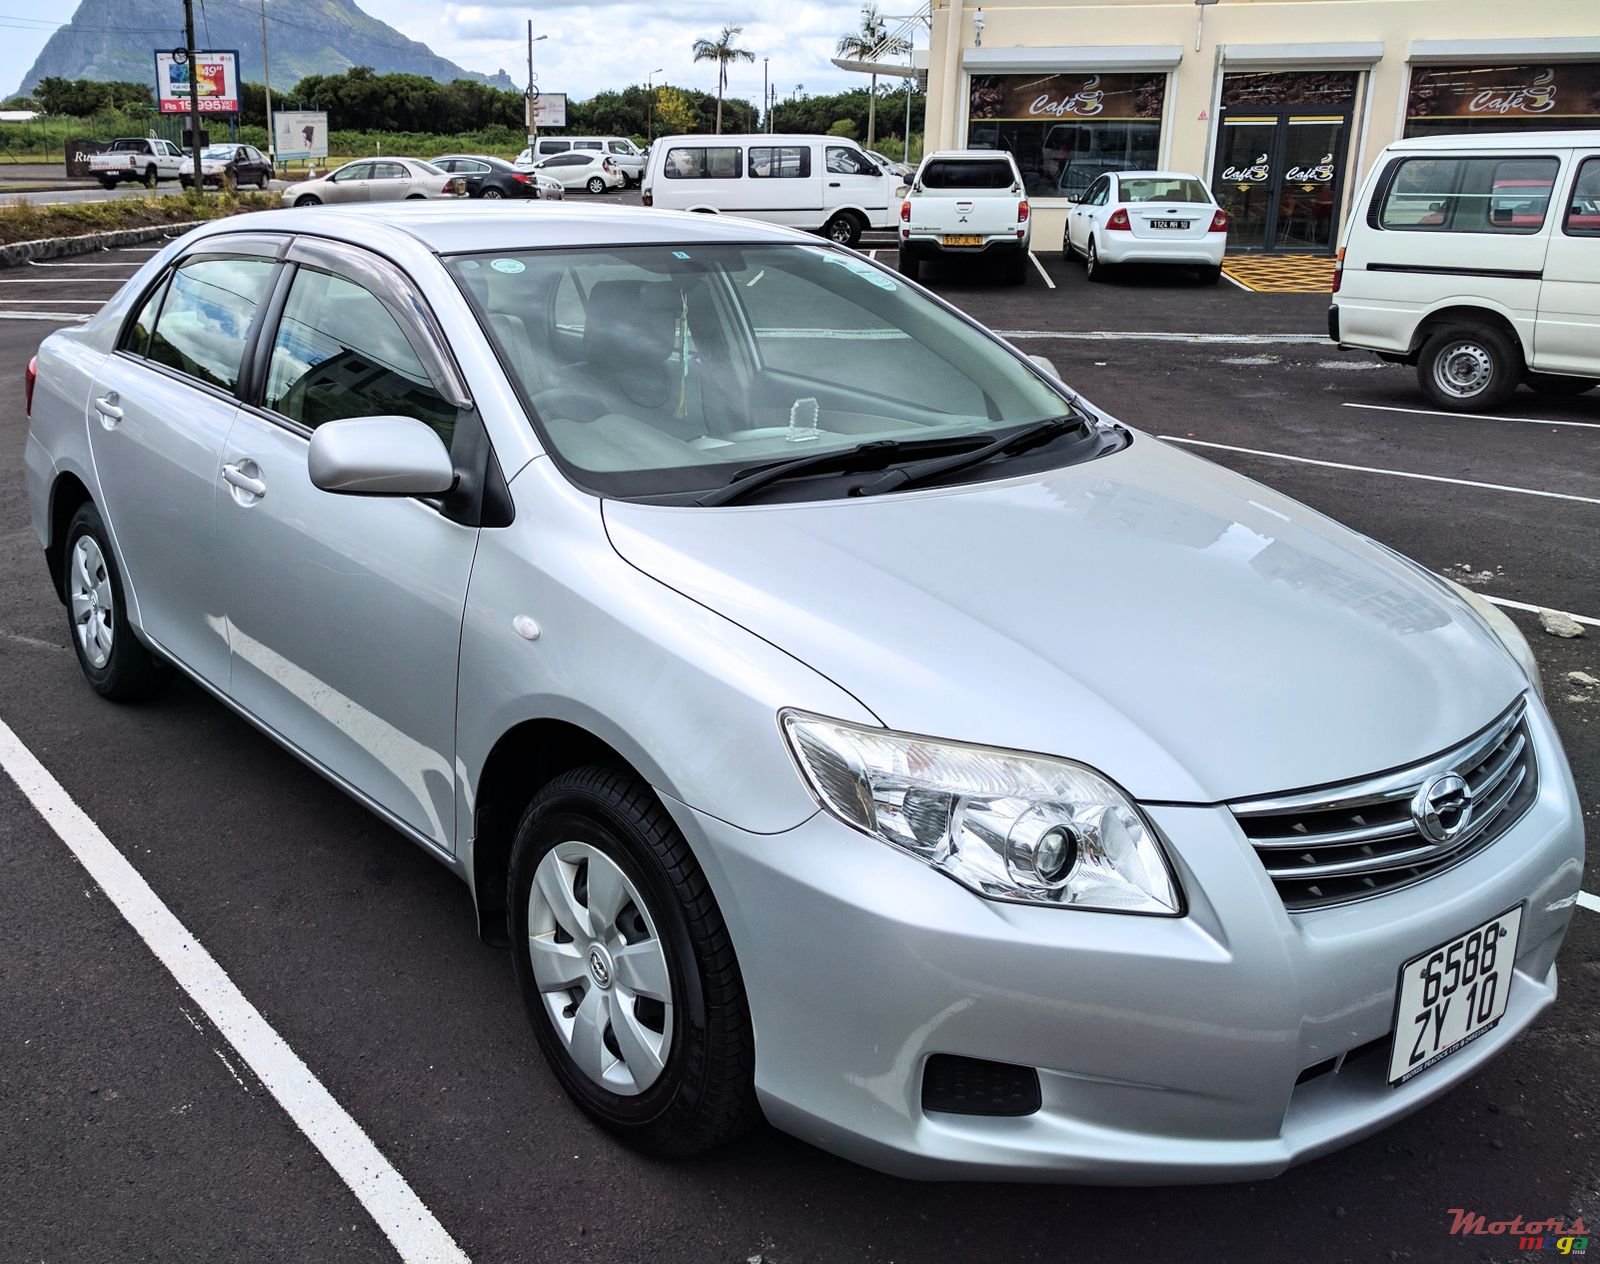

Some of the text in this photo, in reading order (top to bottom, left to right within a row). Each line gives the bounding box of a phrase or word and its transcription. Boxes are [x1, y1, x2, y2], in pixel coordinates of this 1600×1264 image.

[1029, 94, 1076, 117] Café
[1469, 90, 1526, 114] Café
[1222, 166, 1252, 181] Café
[1286, 166, 1316, 181] Café
[1422, 921, 1500, 1008] 6588
[1408, 971, 1498, 1066] ZY 10
